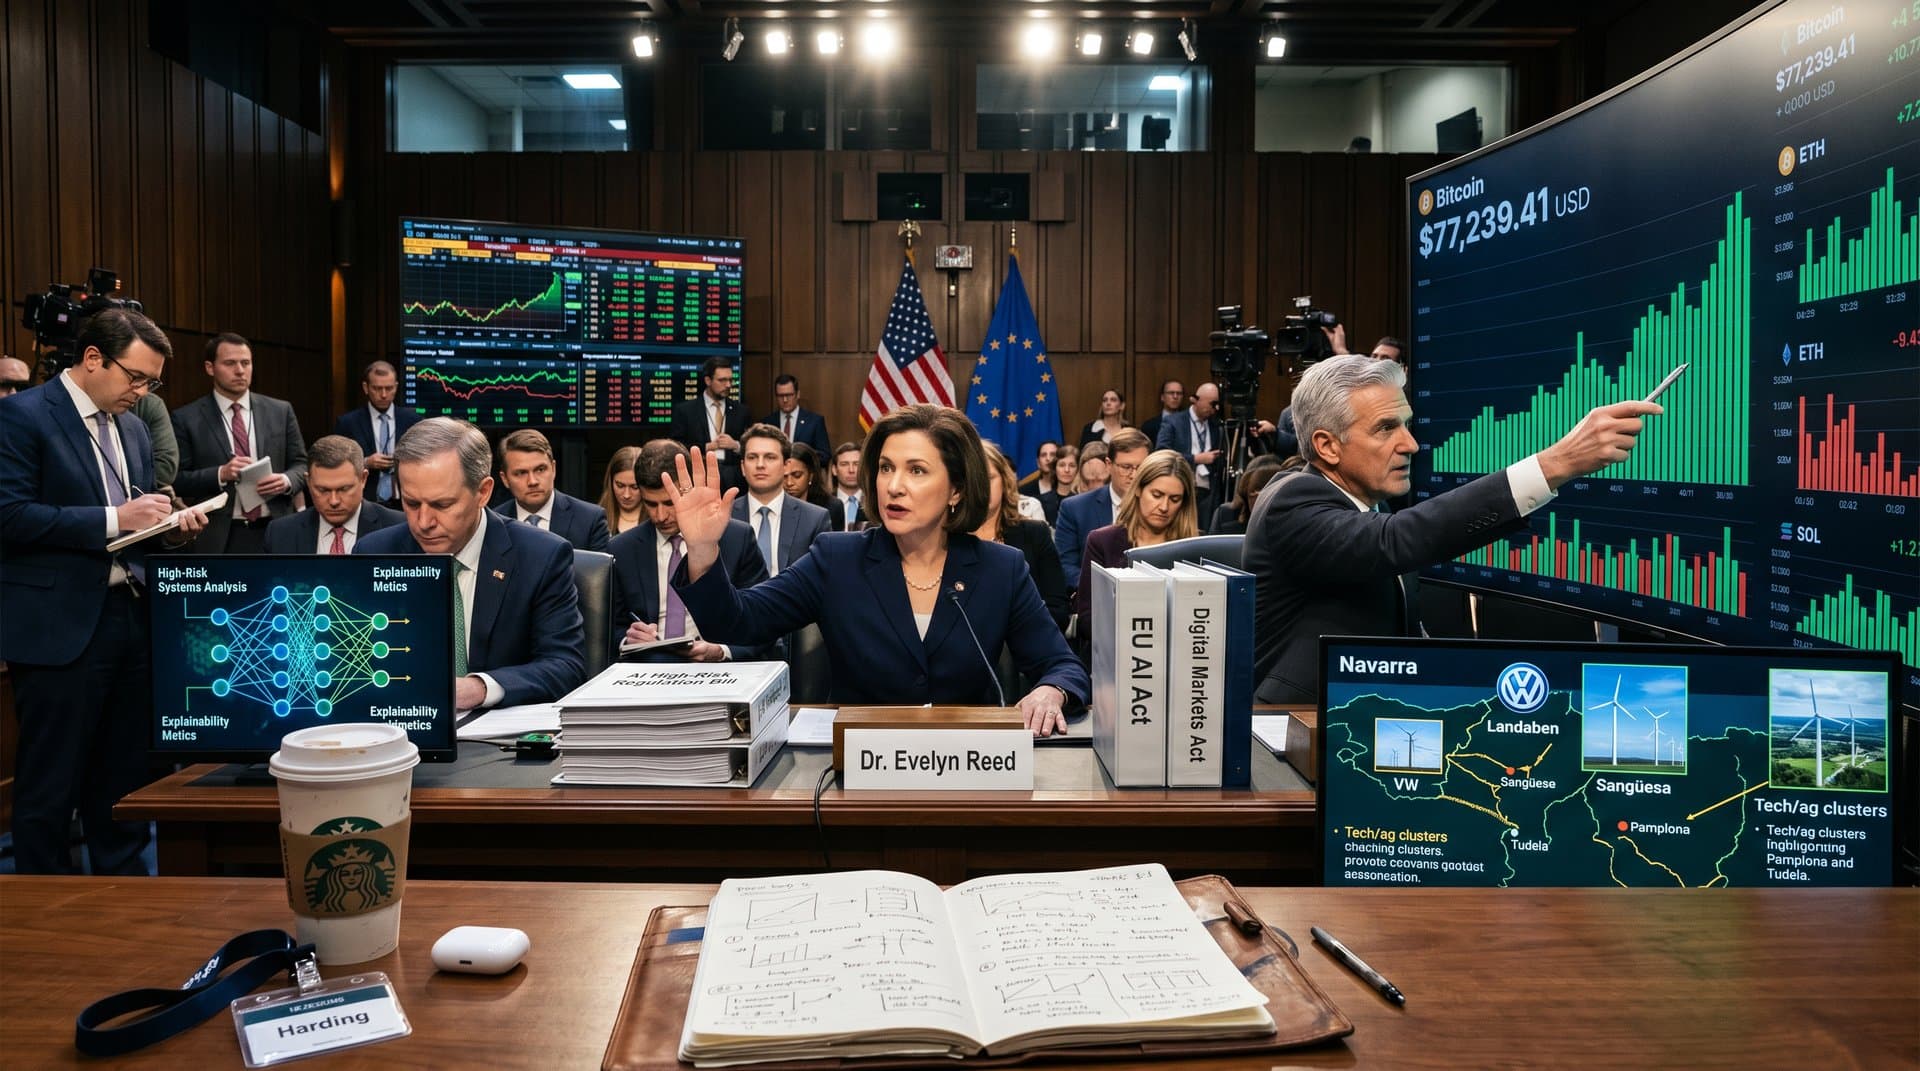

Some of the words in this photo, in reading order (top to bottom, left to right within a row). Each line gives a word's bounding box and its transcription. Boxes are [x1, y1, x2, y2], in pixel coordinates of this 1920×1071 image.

[1797, 6, 1844, 44] Bitcoin
[1776, 32, 1856, 92] $77,239.41
[1813, 80, 1835, 101] USD
[1799, 138, 1825, 164] ETH
[1436, 176, 1485, 208] Bitcoin
[1419, 186, 1549, 259] $77,239.41
[1555, 187, 1590, 217] USD
[1799, 342, 1824, 361] ETH
[1797, 526, 1821, 544] SOL
[158, 567, 208, 581] High-Risk
[373, 566, 441, 580] Explainability
[158, 581, 202, 594] Systems
[204, 581, 248, 594] Analysis
[373, 581, 408, 593] Metics
[1131, 617, 1153, 648] EU
[1188, 608, 1210, 660] Digital
[1131, 656, 1153, 679] AI
[1339, 656, 1418, 675] Navarra
[650, 672, 732, 680] High-Risk
[1131, 686, 1153, 725] Act
[1190, 666, 1209, 730] Markets
[370, 705, 438, 720] Explainability
[162, 715, 230, 730] Explainability
[1487, 720, 1560, 735] Landaben
[162, 730, 197, 741] Metics
[1189, 735, 1207, 762] Act
[860, 750, 887, 770] Dr.
[895, 750, 960, 776] Evelyn
[967, 750, 1016, 771] Reed
[1393, 777, 1419, 792] VW
[1500, 777, 1556, 790] Sangüese
[1596, 778, 1672, 796] Sangüesa
[1753, 798, 1819, 817] Tech/ag
[1823, 801, 1888, 818] clusters
[1344, 826, 1396, 843] Tech/ag
[1399, 829, 1448, 843] clusters
[1630, 822, 1691, 835] Pamplona
[1766, 824, 1816, 839] Tech/ag
[1818, 827, 1866, 840] clusters
[1397, 844, 1444, 856] clusters.
[1511, 839, 1549, 852] Tudela
[1767, 854, 1828, 868] Pamplona
[1831, 857, 1854, 868] and
[1767, 868, 1811, 881] Tudela.
[278, 1012, 370, 1038] Harding
